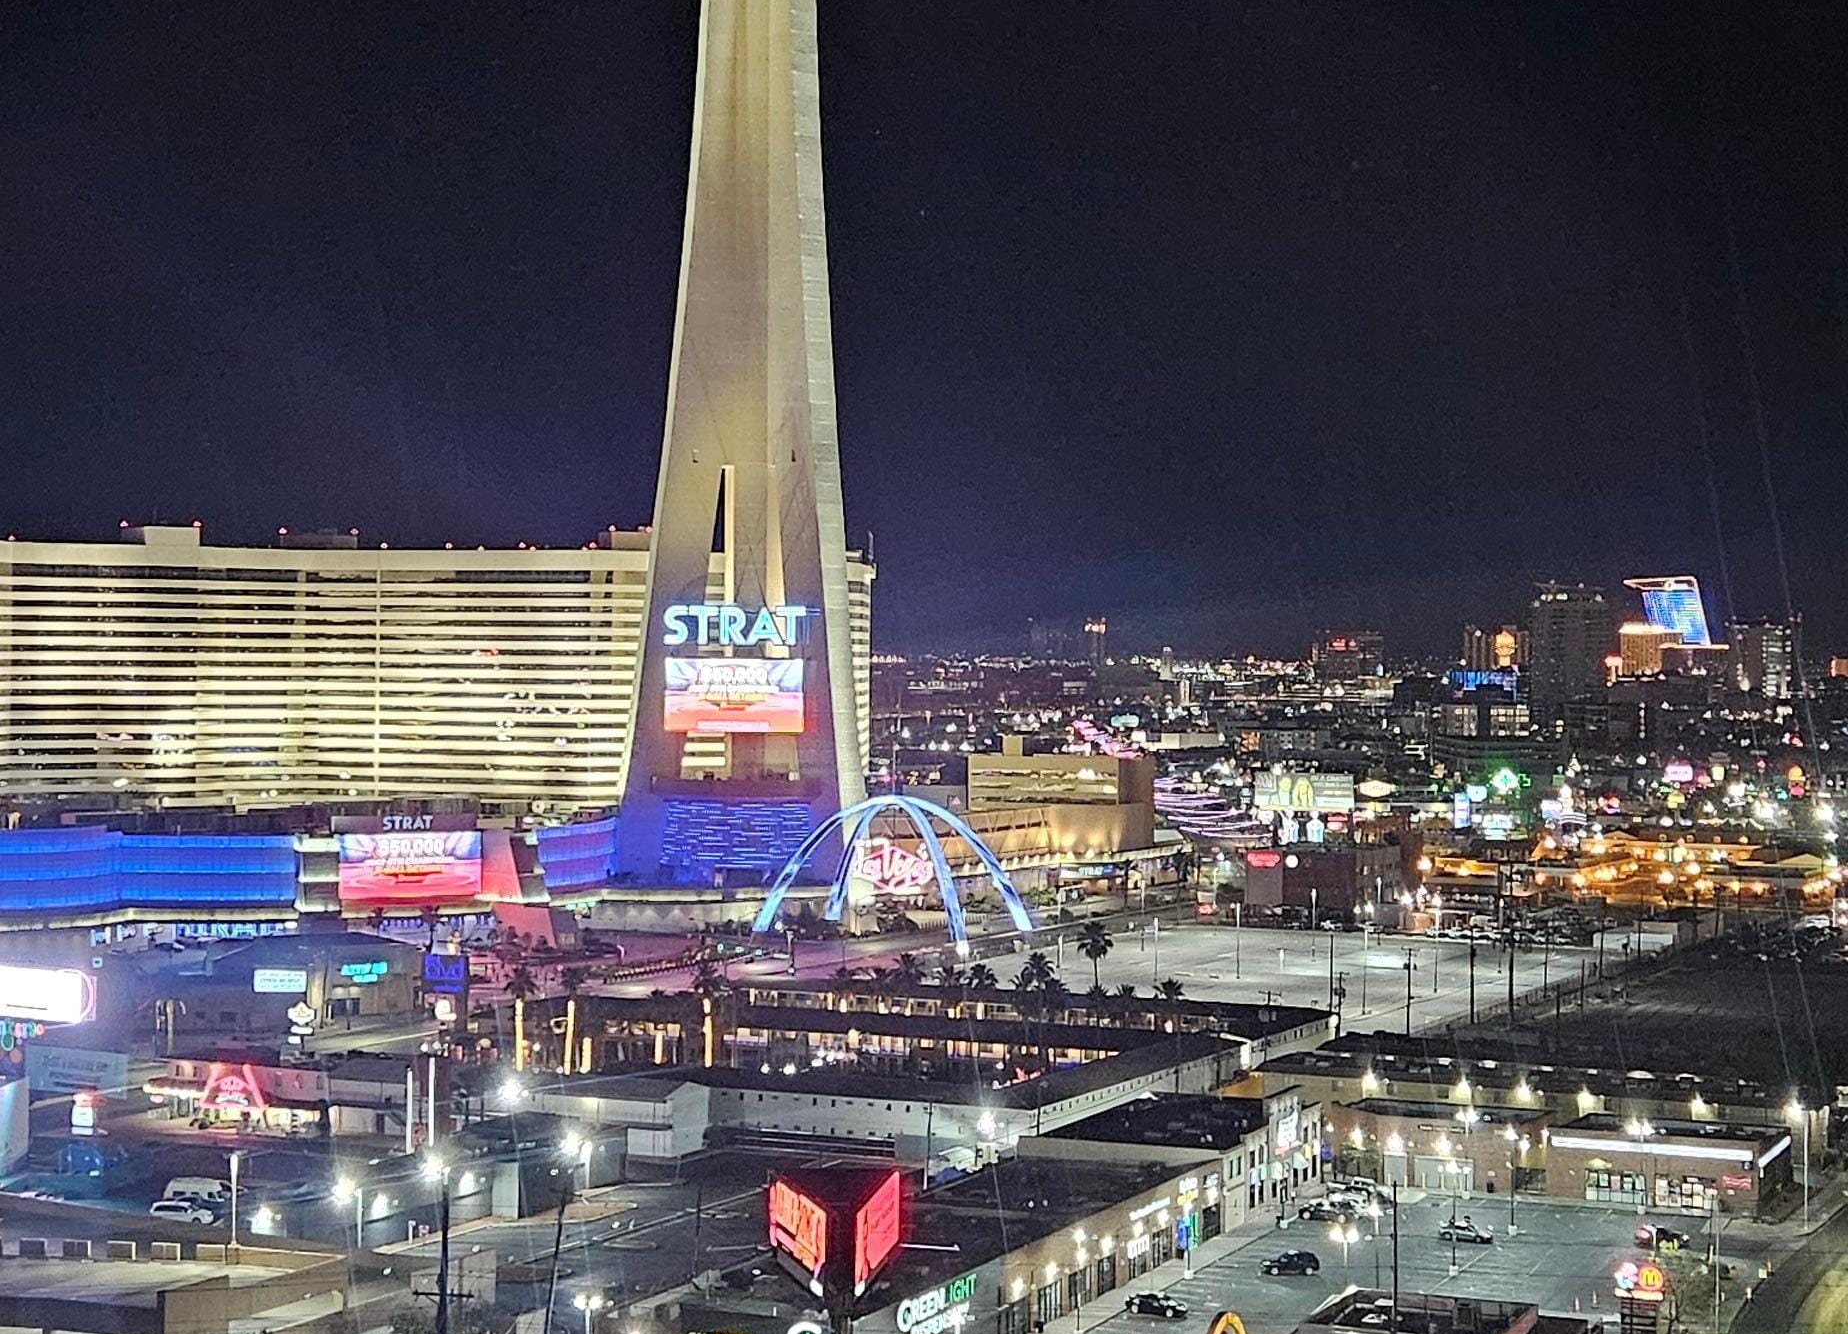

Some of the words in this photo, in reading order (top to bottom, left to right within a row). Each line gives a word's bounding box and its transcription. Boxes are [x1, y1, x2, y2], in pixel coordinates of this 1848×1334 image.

[663, 605, 807, 646] STRAT
[382, 815, 434, 831] STRAT
[377, 838, 445, 857] $50,000
